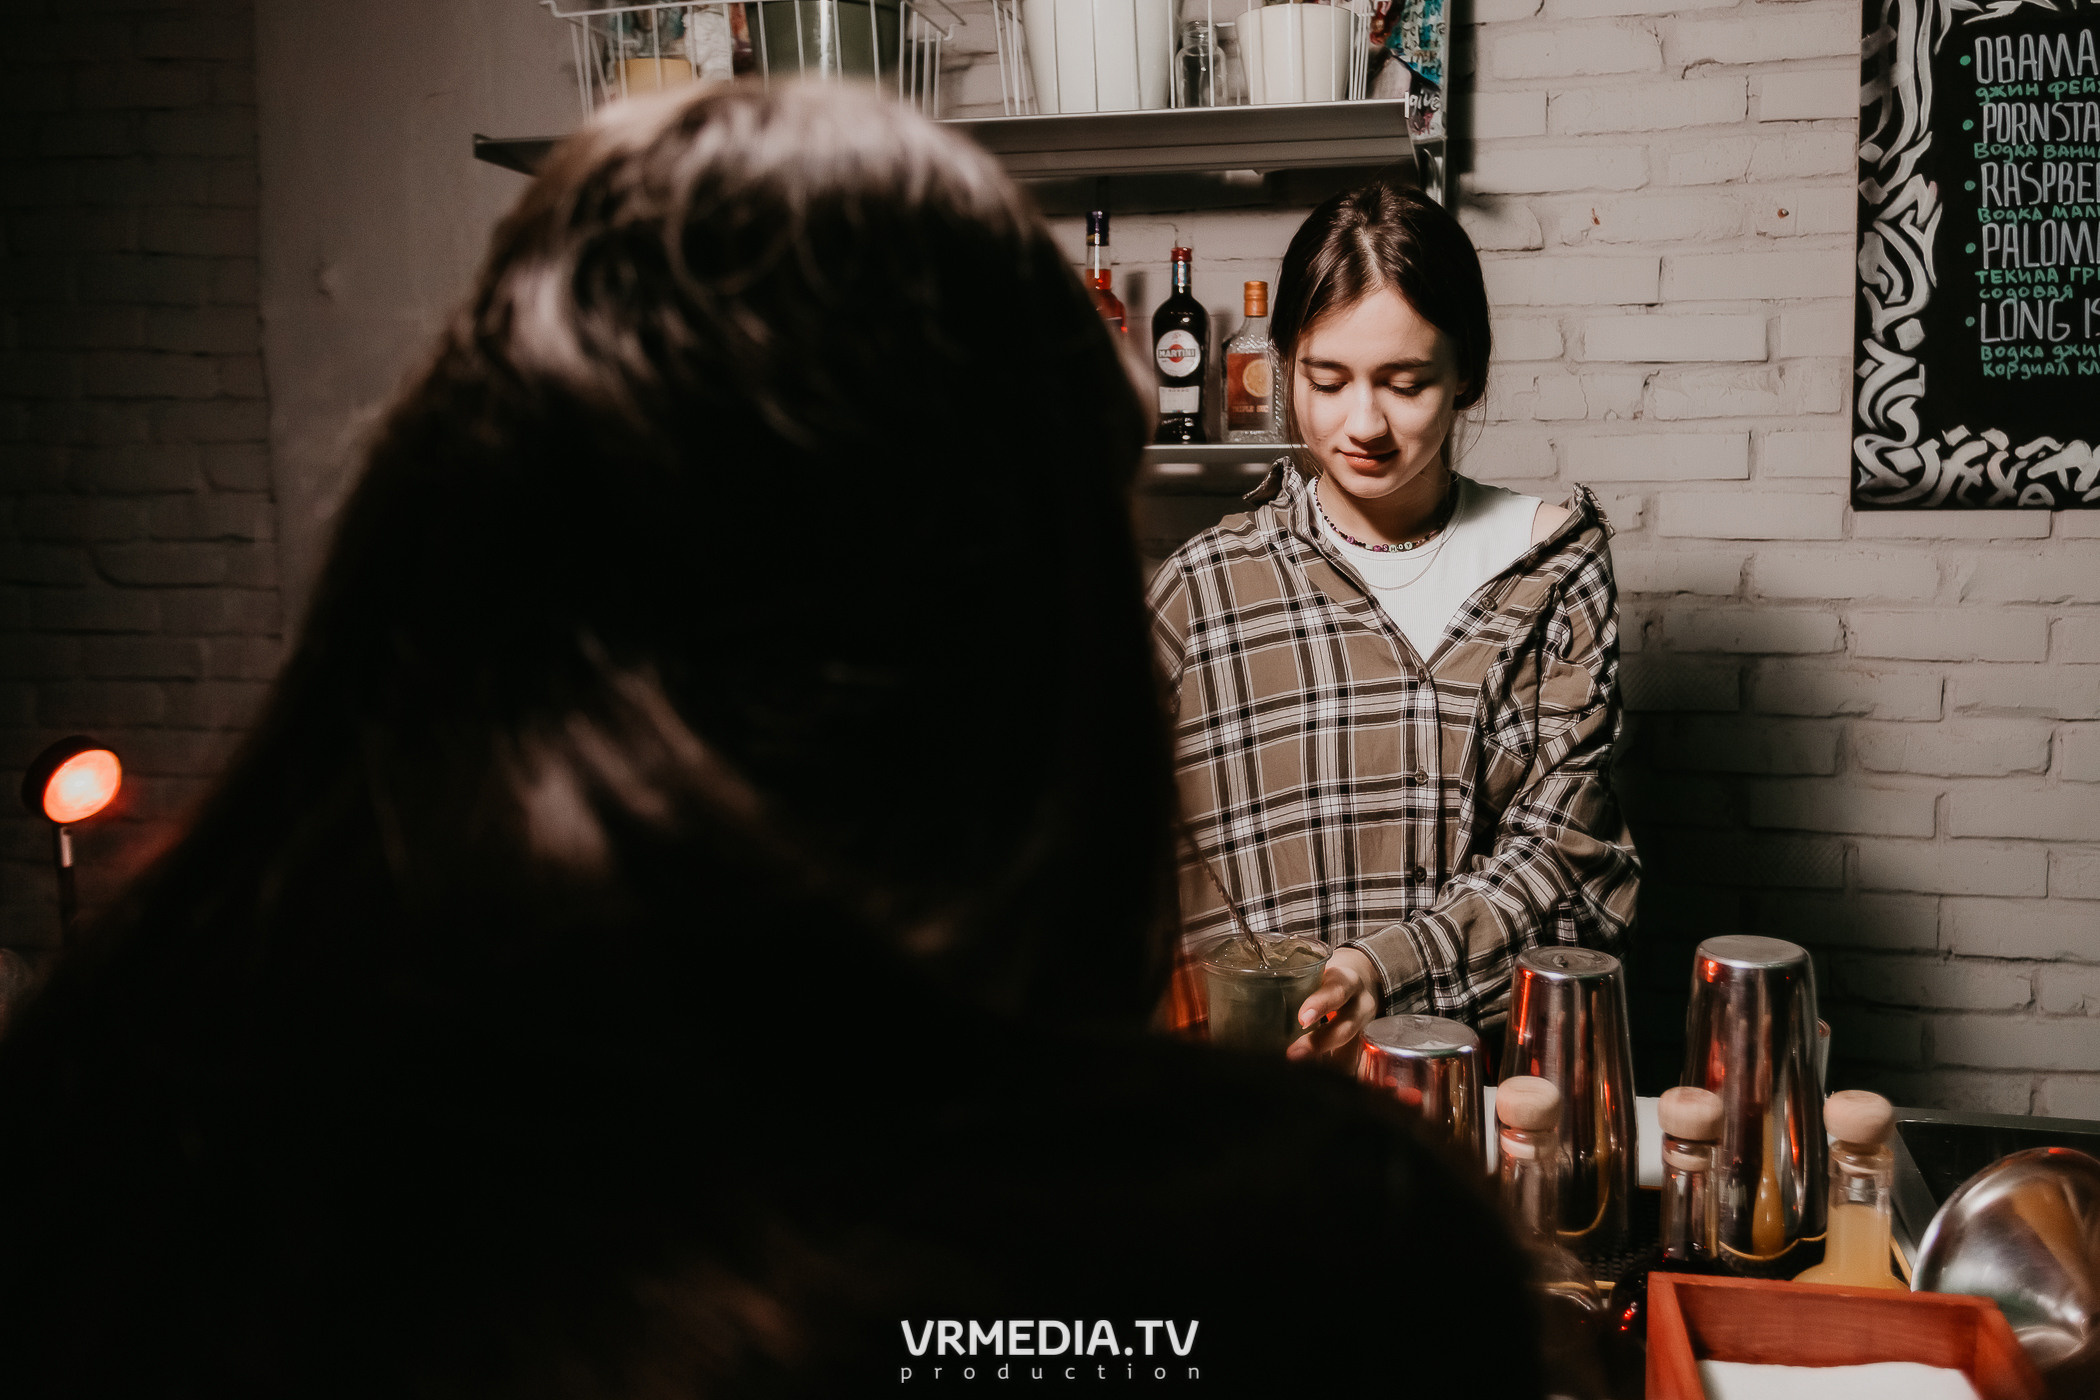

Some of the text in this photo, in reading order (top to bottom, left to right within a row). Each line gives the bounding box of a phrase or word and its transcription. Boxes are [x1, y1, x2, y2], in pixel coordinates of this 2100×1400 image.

[1975, 28, 2099, 84] OBAMA
[2047, 77, 2100, 101] ФЕЙ
[2043, 144, 2100, 159] ВАНИ
[1982, 219, 2100, 270] PALOM
[1975, 267, 2100, 285] ТЕКИЛА ГР
[1980, 298, 2071, 343] LONG
